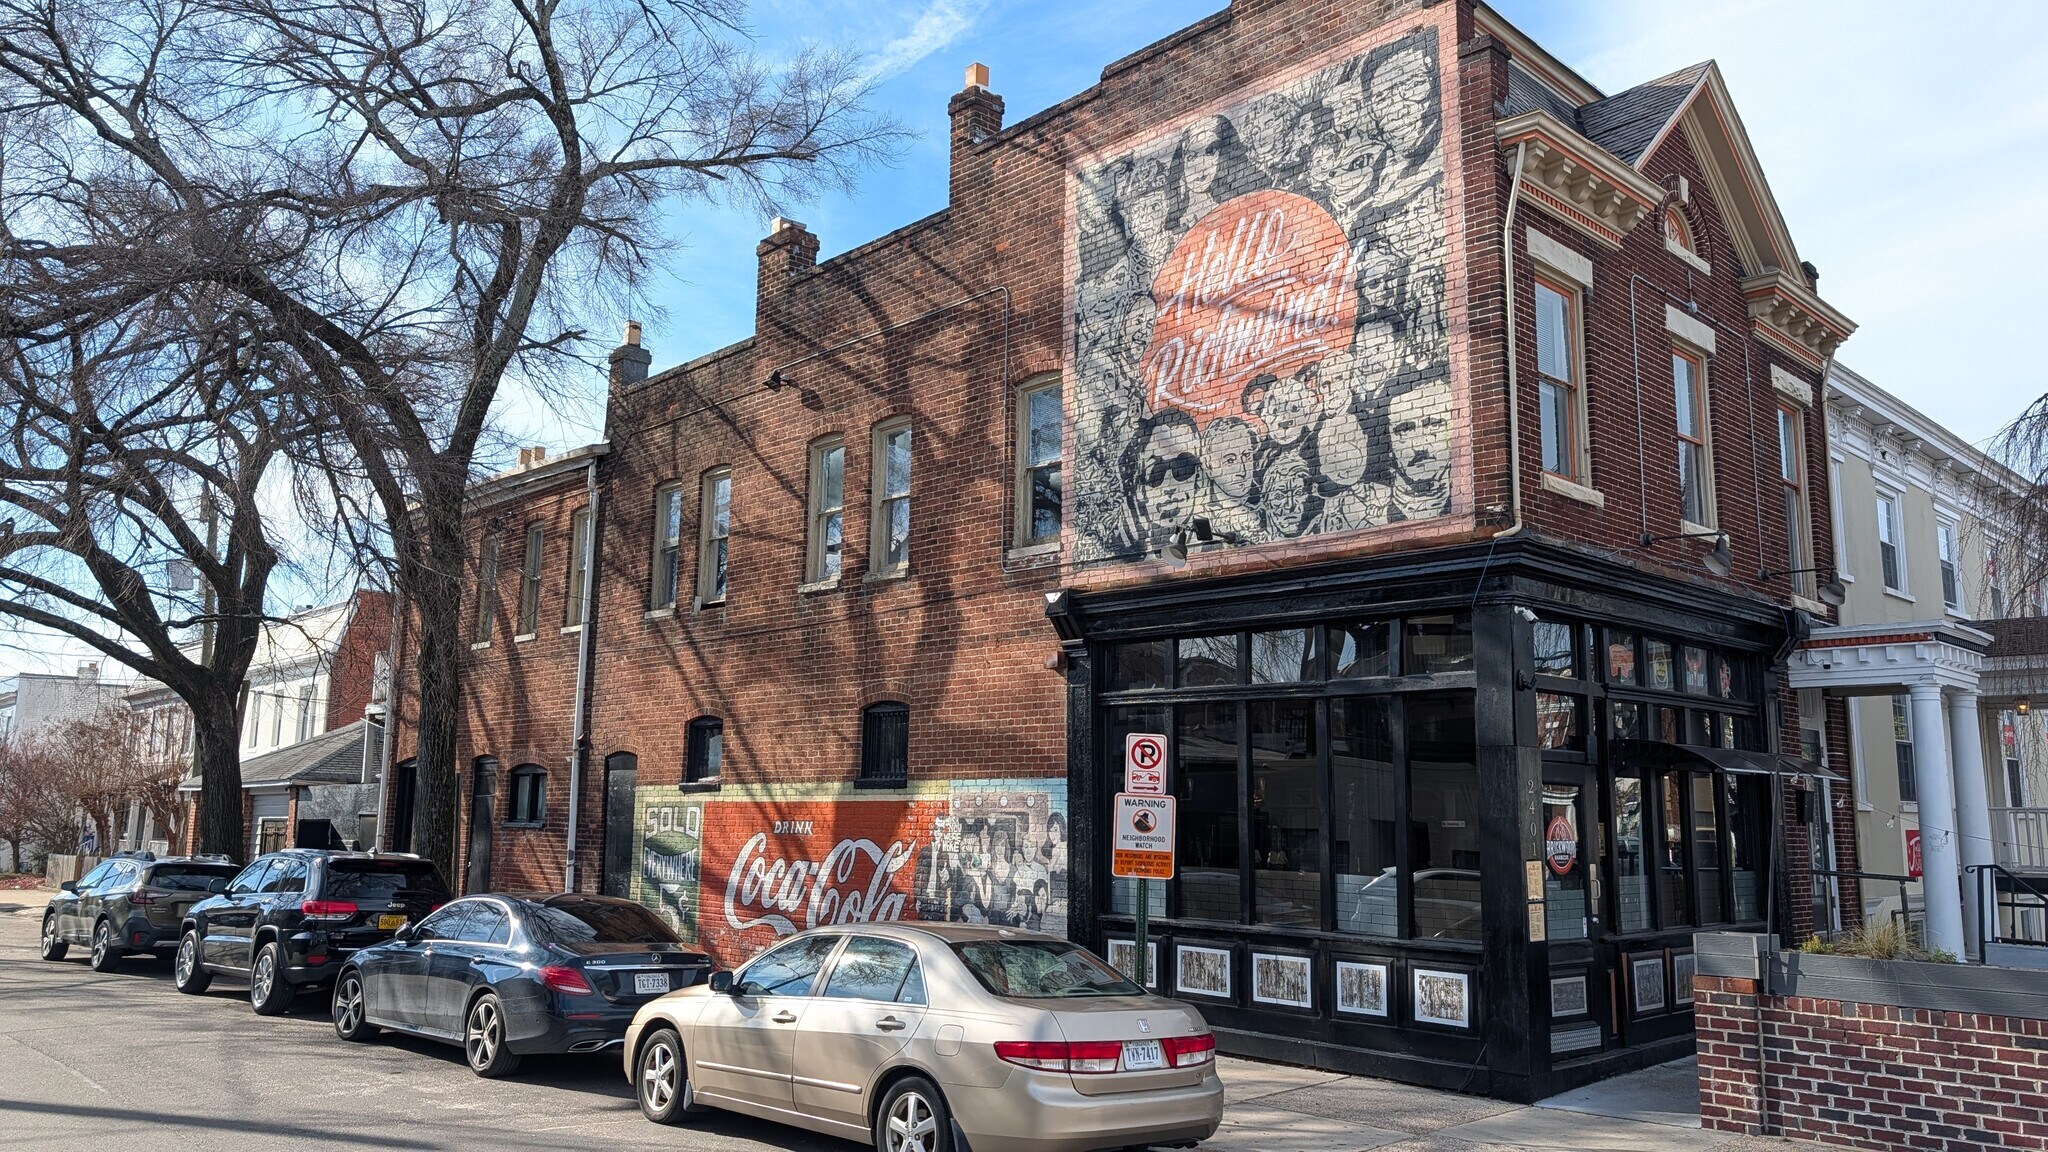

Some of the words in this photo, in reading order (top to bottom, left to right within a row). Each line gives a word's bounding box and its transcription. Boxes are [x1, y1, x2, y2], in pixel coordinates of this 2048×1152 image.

[1156, 208, 1297, 324] Hello
[1124, 799, 1166, 808] WARNING
[645, 806, 701, 840] SOLD
[773, 821, 814, 835] DRINK
[1122, 834, 1165, 843] NEIGHBORHOOD
[643, 847, 698, 882] EVERYWHERE
[638, 978, 668, 988] TGT-7338
